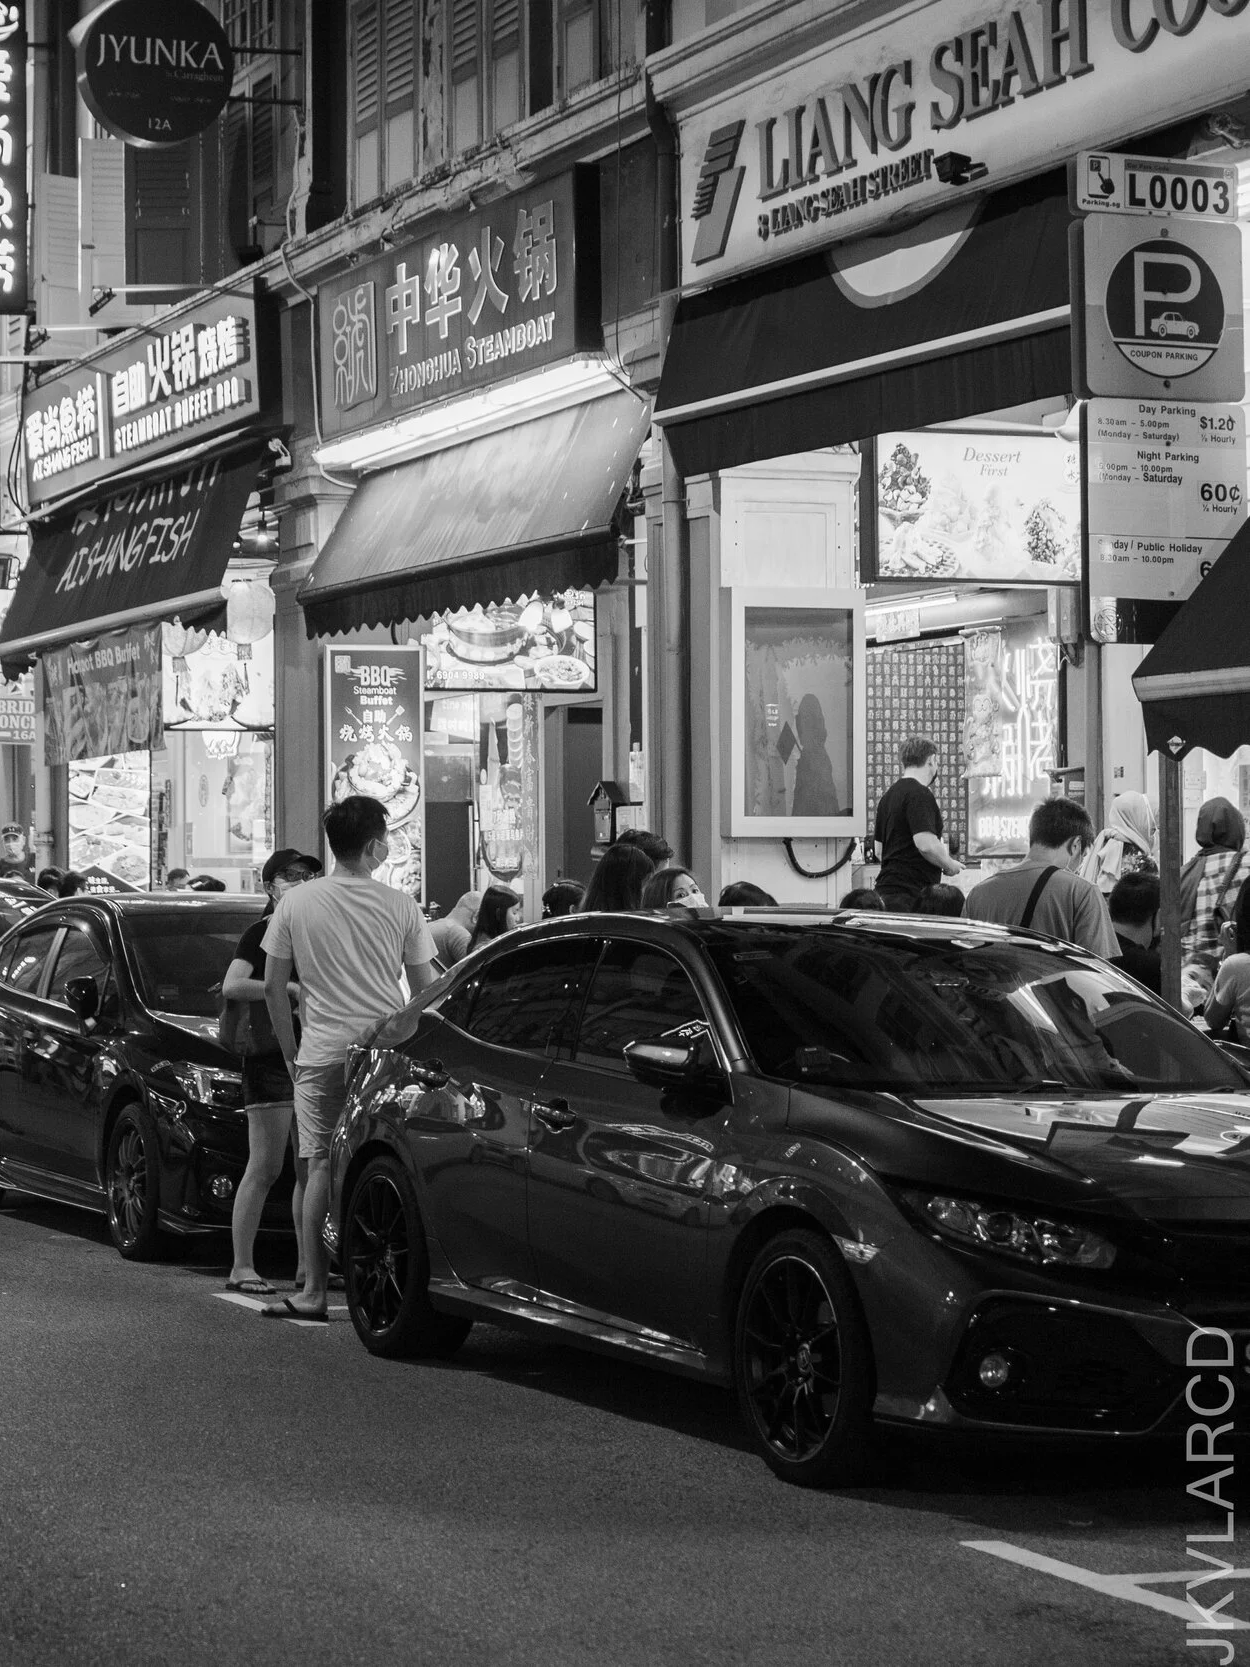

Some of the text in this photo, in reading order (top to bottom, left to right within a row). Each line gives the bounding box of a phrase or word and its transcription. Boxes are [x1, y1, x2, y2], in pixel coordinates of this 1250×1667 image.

[96, 33, 224, 70] JYUNKA
[755, 0, 1094, 201] LIANG SEAH
[148, 117, 172, 131] 12A
[757, 149, 935, 241] 8 LIANG SEAH STREET
[1129, 173, 1230, 214] L0003
[1082, 198, 1121, 208] Parking.sg
[385, 200, 558, 355] 中华火锅
[1134, 251, 1201, 336] P
[389, 311, 556, 398] ZHONGHUA STEAMBOAT
[1130, 350, 1198, 361] COUPON PARKING
[114, 376, 239, 454] STEAMBOAT BUFFET BBQ
[1139, 404, 1196, 417] Day Parking
[1097, 418, 1170, 429] 8.30am 5.00pm
[1200, 416, 1236, 431] $1.20
[1097, 429, 1180, 442] (Monday Saturday)
[1211, 434, 1236, 445] Hourly
[963, 447, 1021, 463] Dessert
[1137, 450, 1199, 463] Night Parking
[980, 463, 1008, 477] First
[1140, 464, 1173, 474] 10.00pm
[1143, 473, 1183, 486] Saturday
[1212, 504, 1238, 515] Hourly
[1137, 542, 1166, 552] Public
[1169, 543, 1203, 554] Holiday
[1142, 555, 1174, 565] 10.00pm
[94, 647, 114, 669] BBQ
[115, 642, 141, 664] Buffet
[360, 665, 391, 687] BBQ
[353, 686, 397, 695] Steamboat
[360, 695, 393, 706] Buffet
[362, 709, 387, 724] 自助
